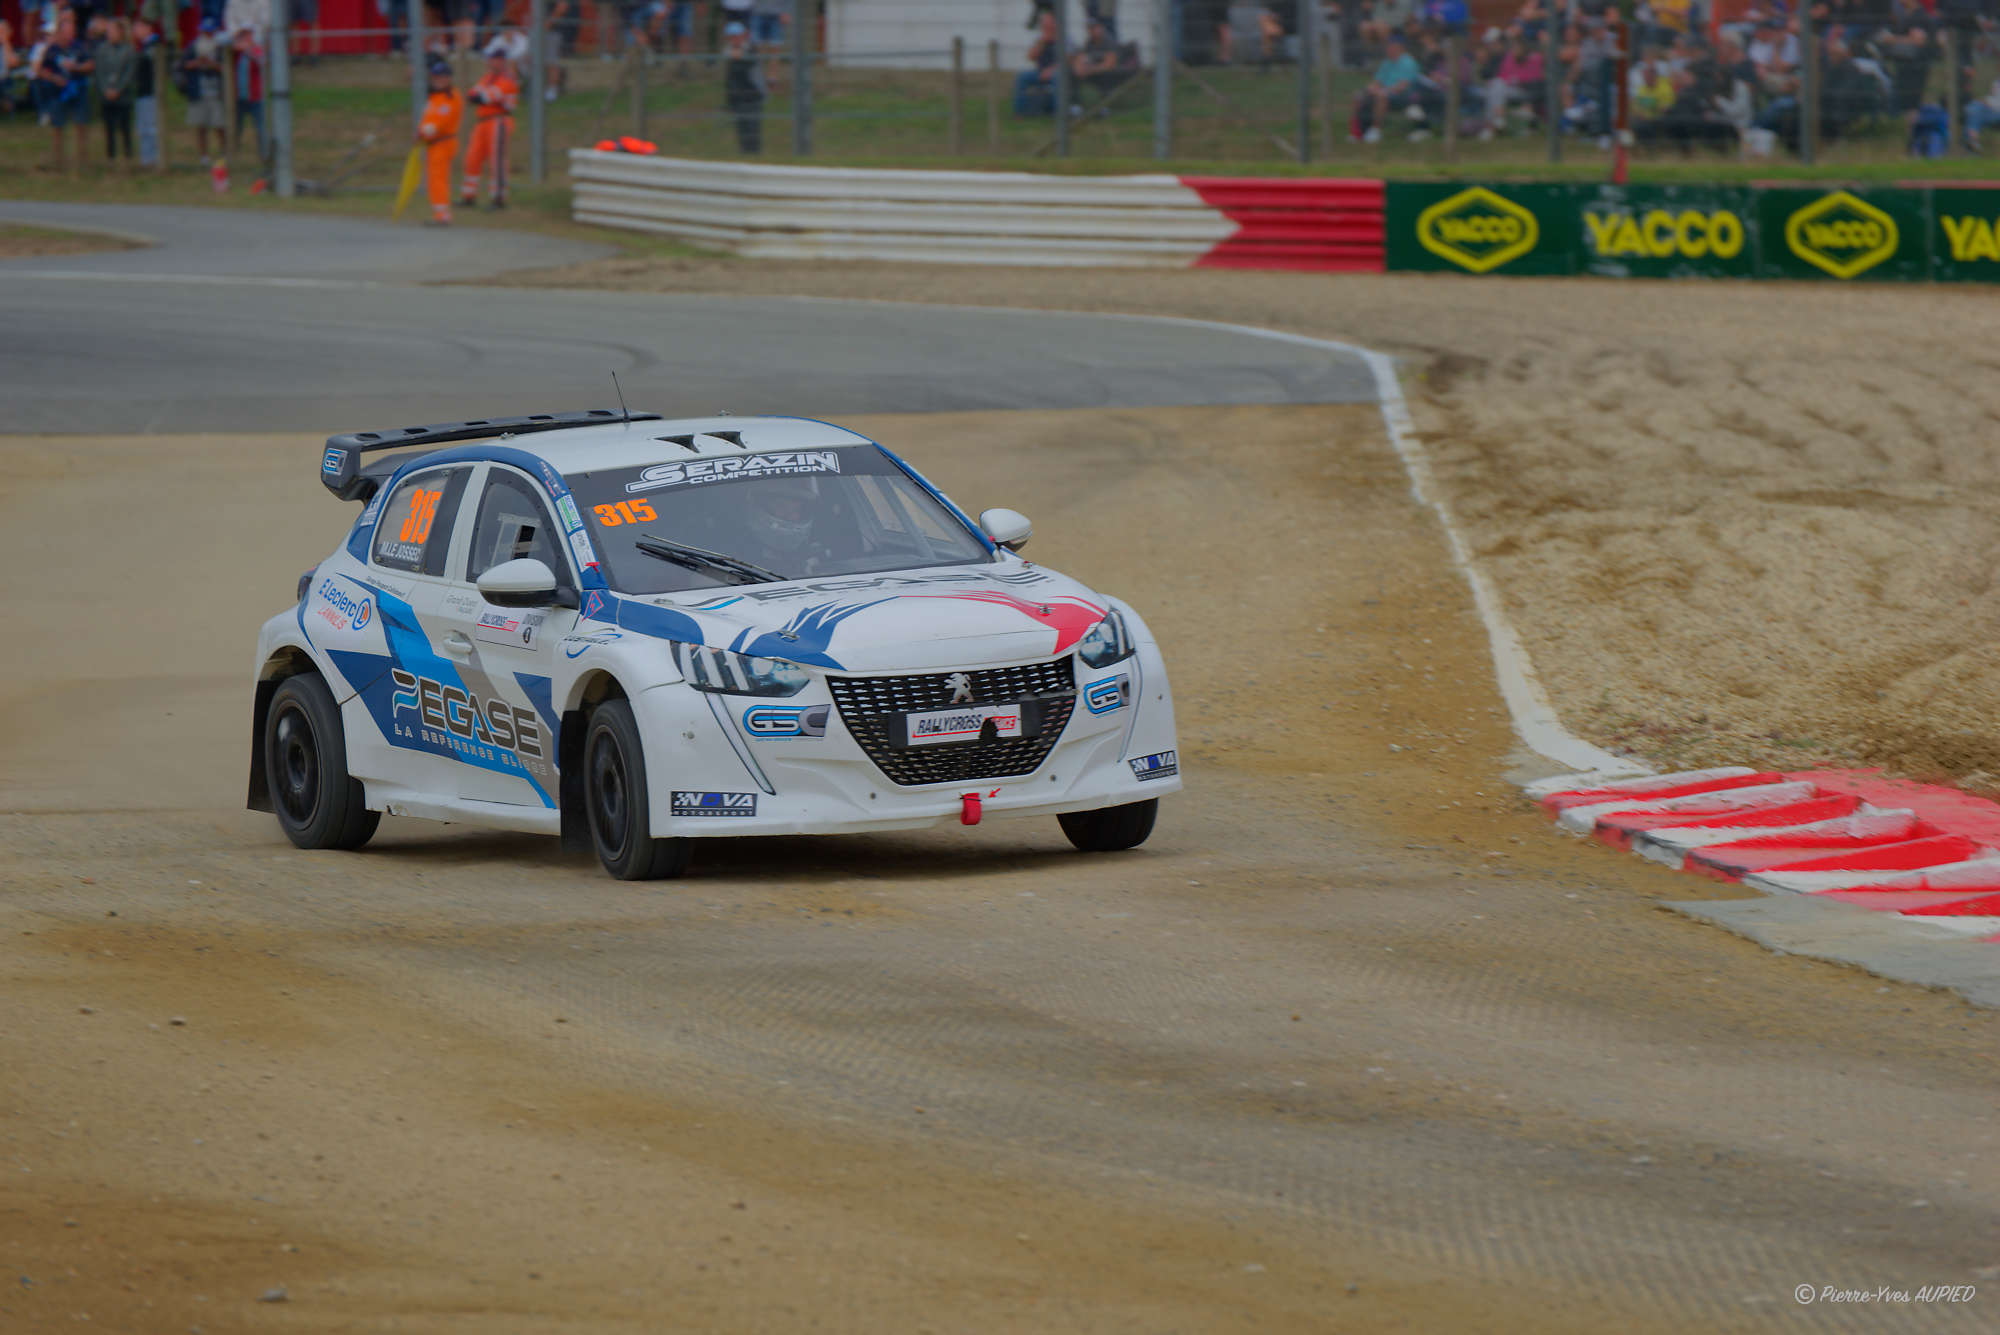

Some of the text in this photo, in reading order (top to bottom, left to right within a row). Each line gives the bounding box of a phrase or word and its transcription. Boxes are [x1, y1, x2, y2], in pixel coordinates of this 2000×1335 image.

[1436, 214, 1520, 244] YACCO
[1582, 211, 1745, 259] YACCO
[1803, 219, 1881, 248] YACCO
[1941, 215, 2000, 261] YA
[626, 452, 841, 493] SERAZIN
[689, 465, 828, 485] COMPETITION
[400, 488, 442, 545] 315
[593, 498, 659, 527] 315
[392, 667, 544, 760] PEGASE
[917, 714, 982, 734] RALLYCROSS
[674, 792, 754, 807] NOVA
